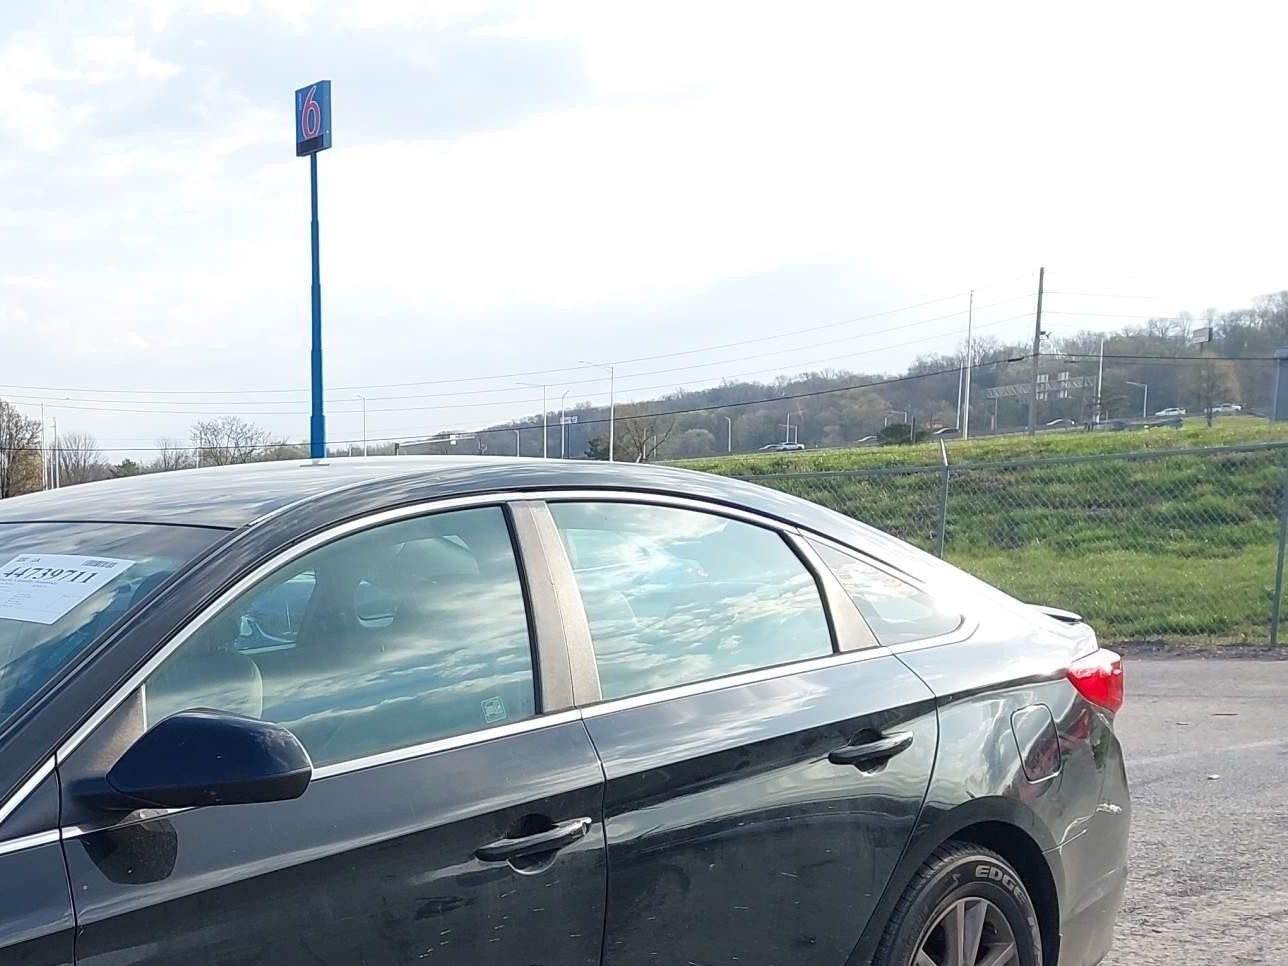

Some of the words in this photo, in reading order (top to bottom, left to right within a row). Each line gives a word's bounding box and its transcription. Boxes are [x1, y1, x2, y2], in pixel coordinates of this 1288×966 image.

[302, 85, 321, 139] 6
[3, 567, 98, 583] 44739711
[975, 864, 1028, 905] EDGE
